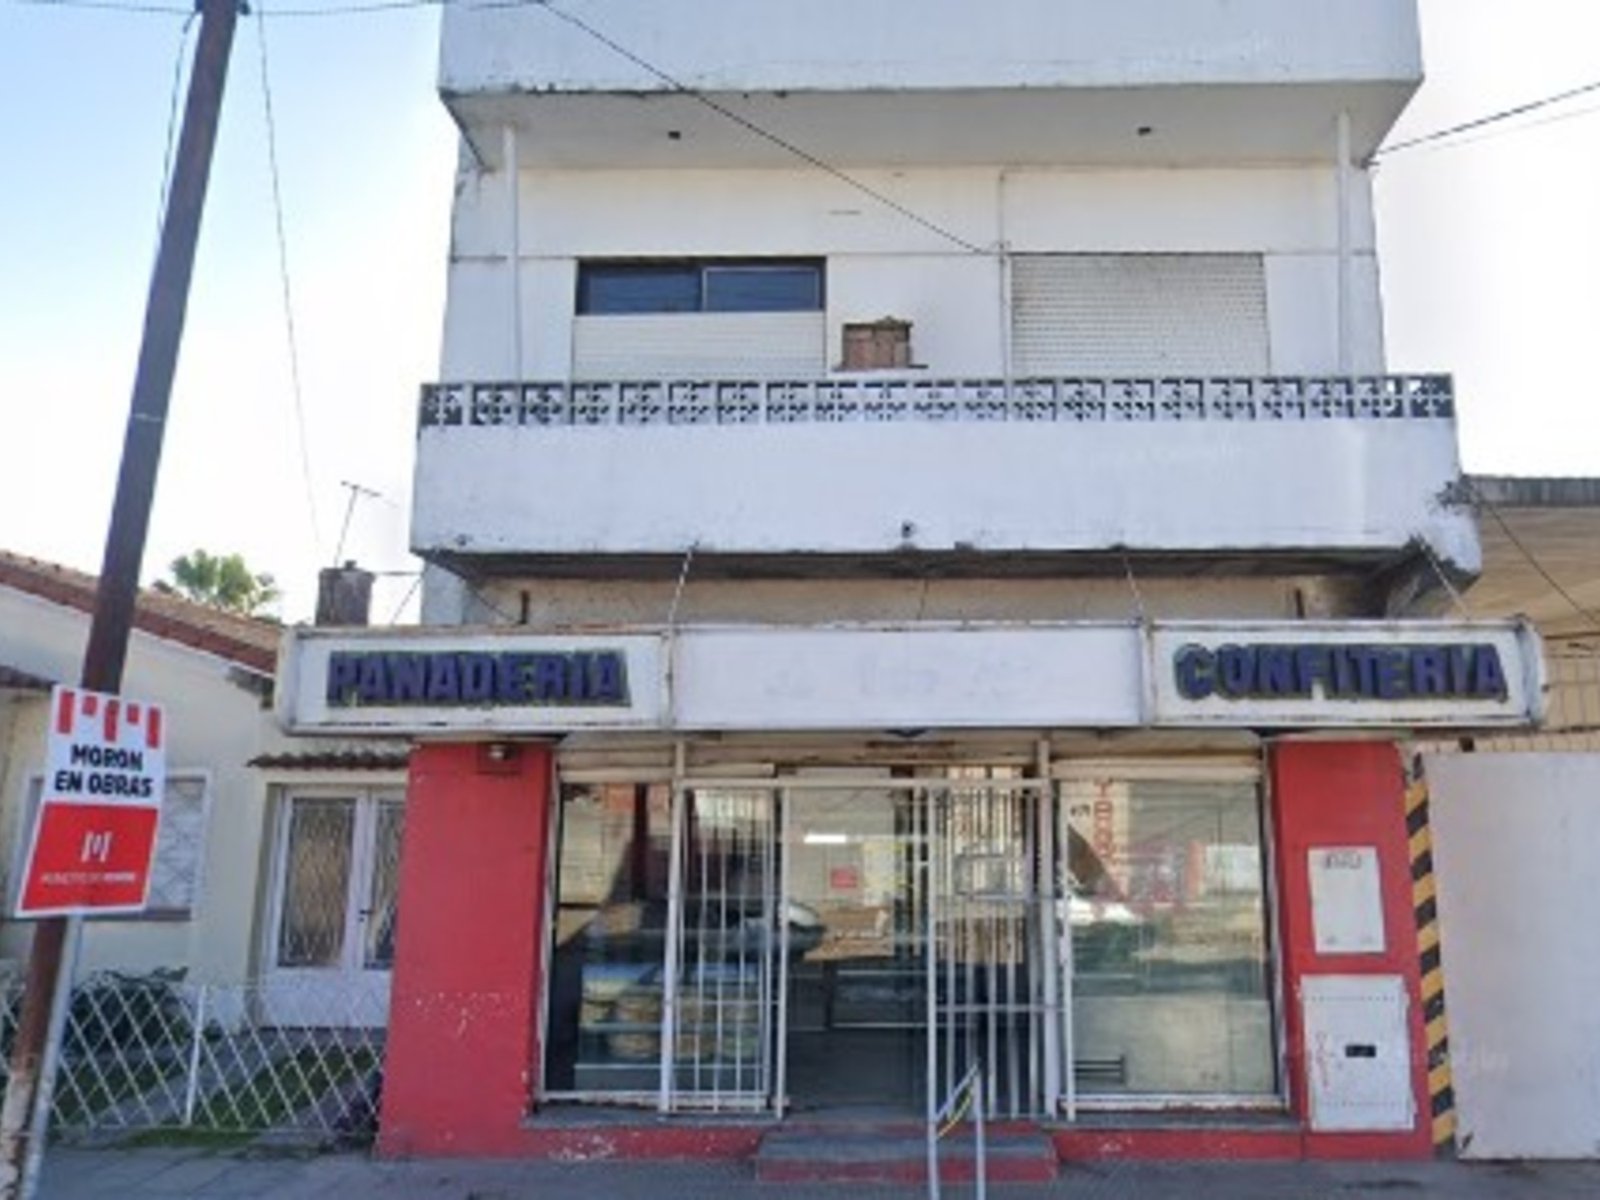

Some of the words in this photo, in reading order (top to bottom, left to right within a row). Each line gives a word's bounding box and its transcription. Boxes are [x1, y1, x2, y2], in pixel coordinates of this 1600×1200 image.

[327, 651, 631, 707] PANADERIA
[1174, 643, 1507, 702] CONFITERIA
[71, 744, 143, 771] MORON
[54, 770, 83, 793] EN
[88, 773, 154, 797] OBRAS
